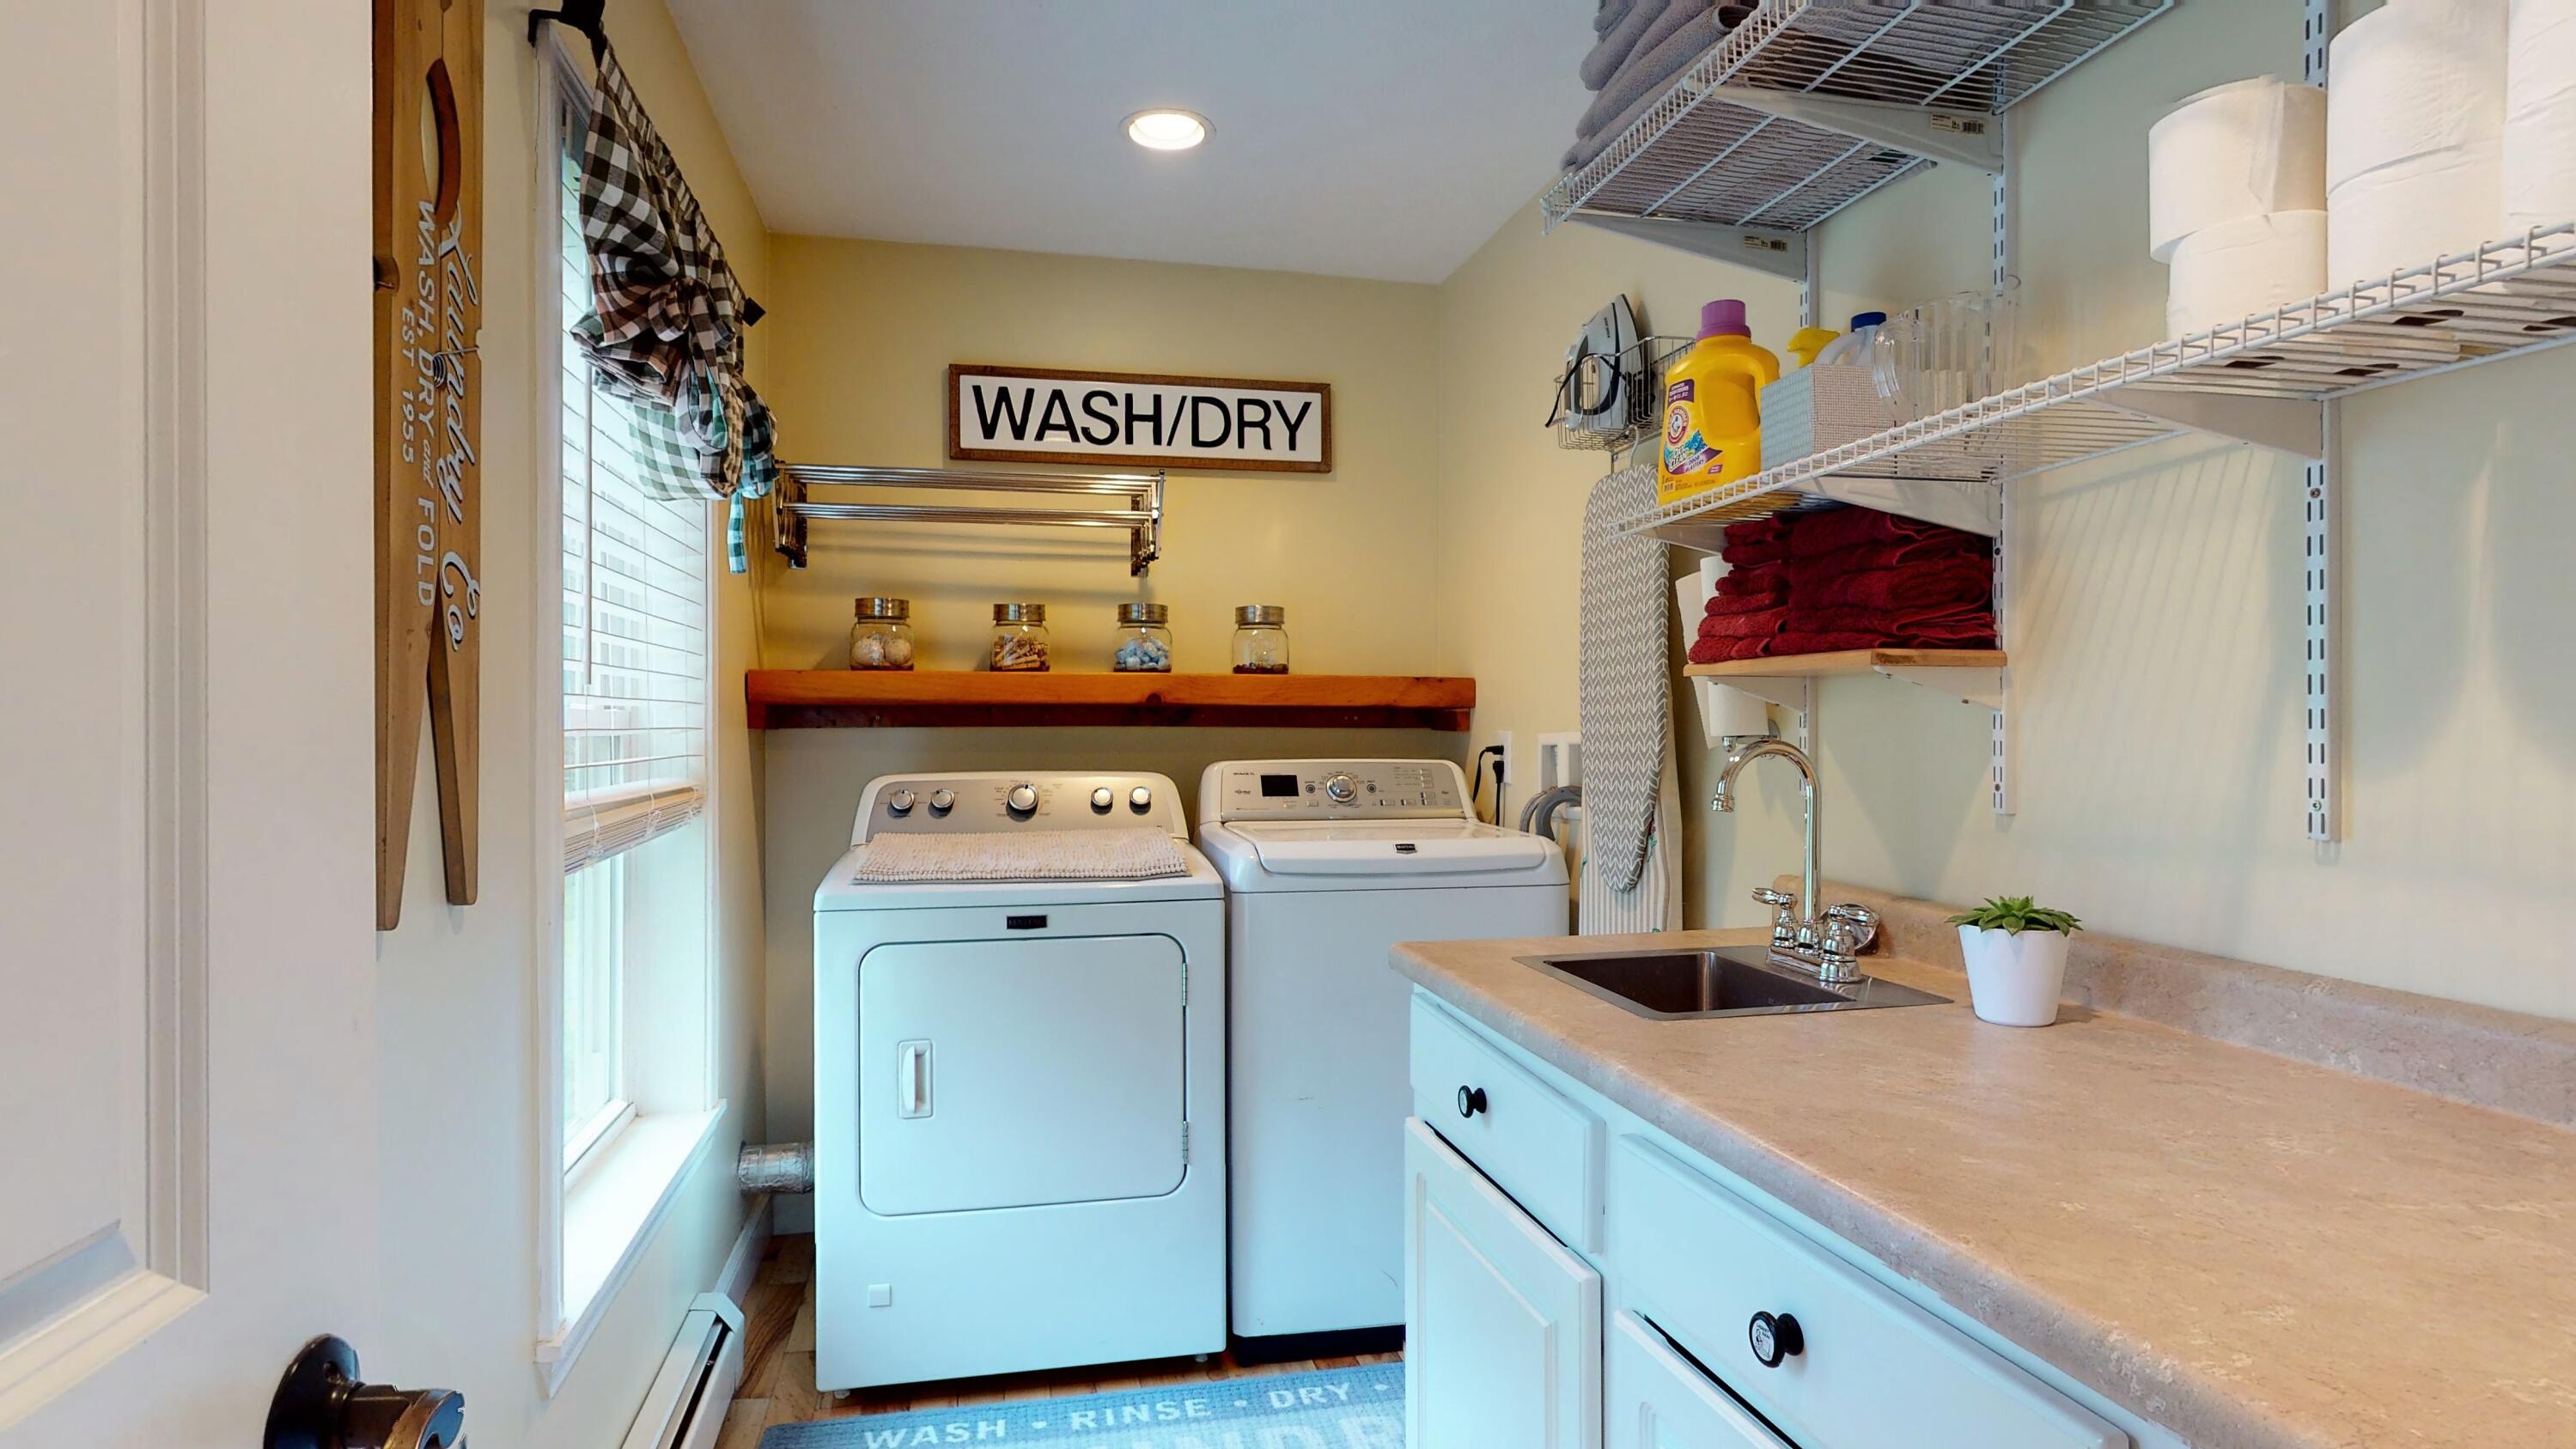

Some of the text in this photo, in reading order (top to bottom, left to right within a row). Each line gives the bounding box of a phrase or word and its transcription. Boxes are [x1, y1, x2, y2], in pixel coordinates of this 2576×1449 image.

[401, 307, 415, 463] EST 1955
[417, 201, 435, 606] WASH, DRY and FOLD
[436, 200, 480, 651] Laundry Co
[971, 385, 1312, 452] WASH/DRY
[863, 1382, 1350, 1449] WASH RINSE DRY
